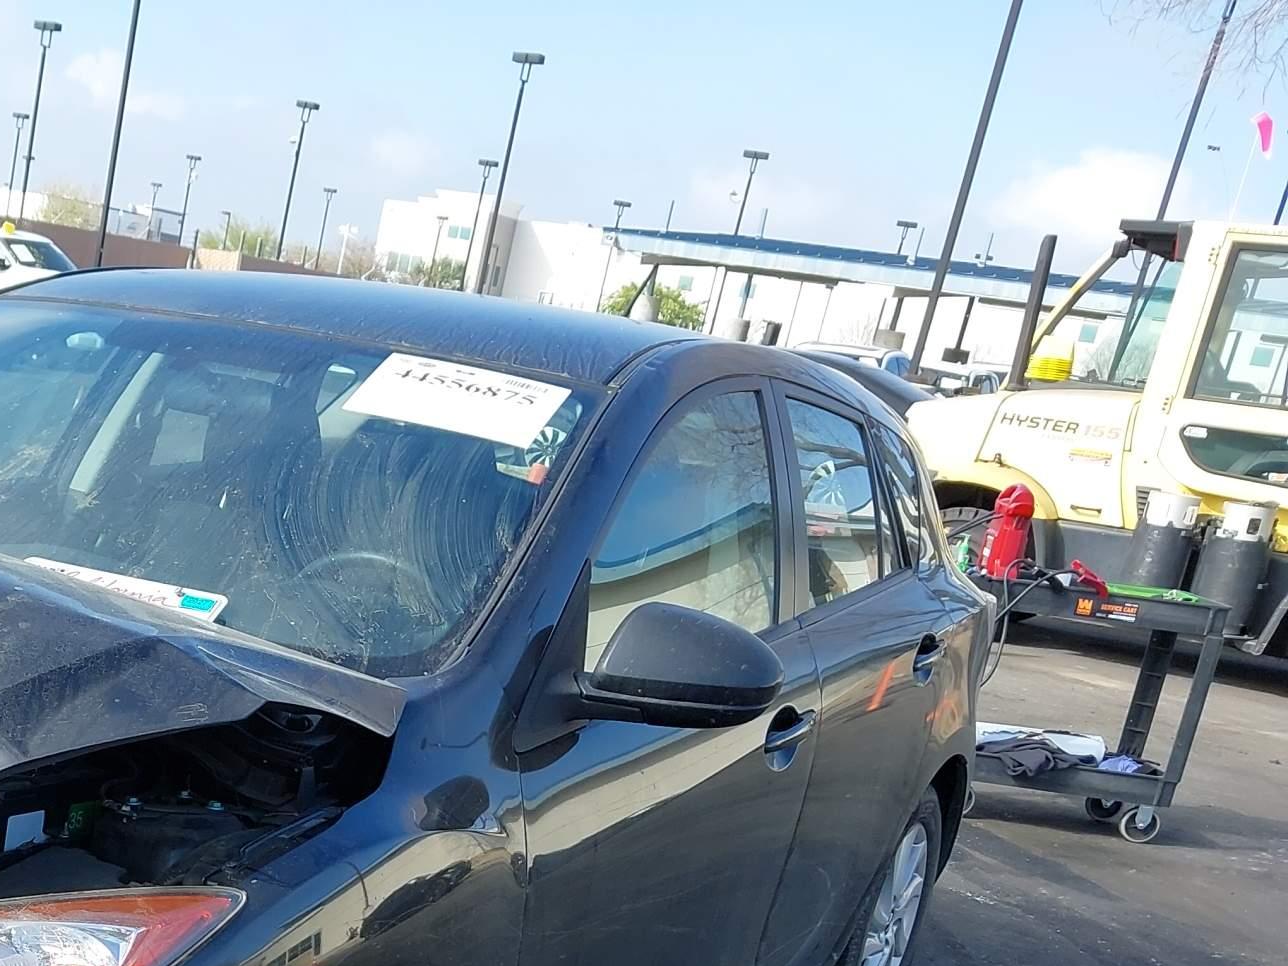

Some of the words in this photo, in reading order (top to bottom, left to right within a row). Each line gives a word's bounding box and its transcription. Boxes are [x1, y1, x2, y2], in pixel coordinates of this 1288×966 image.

[394, 369, 538, 406] 44556875
[1000, 412, 1080, 435] HYSTER
[1084, 424, 1122, 440] 155
